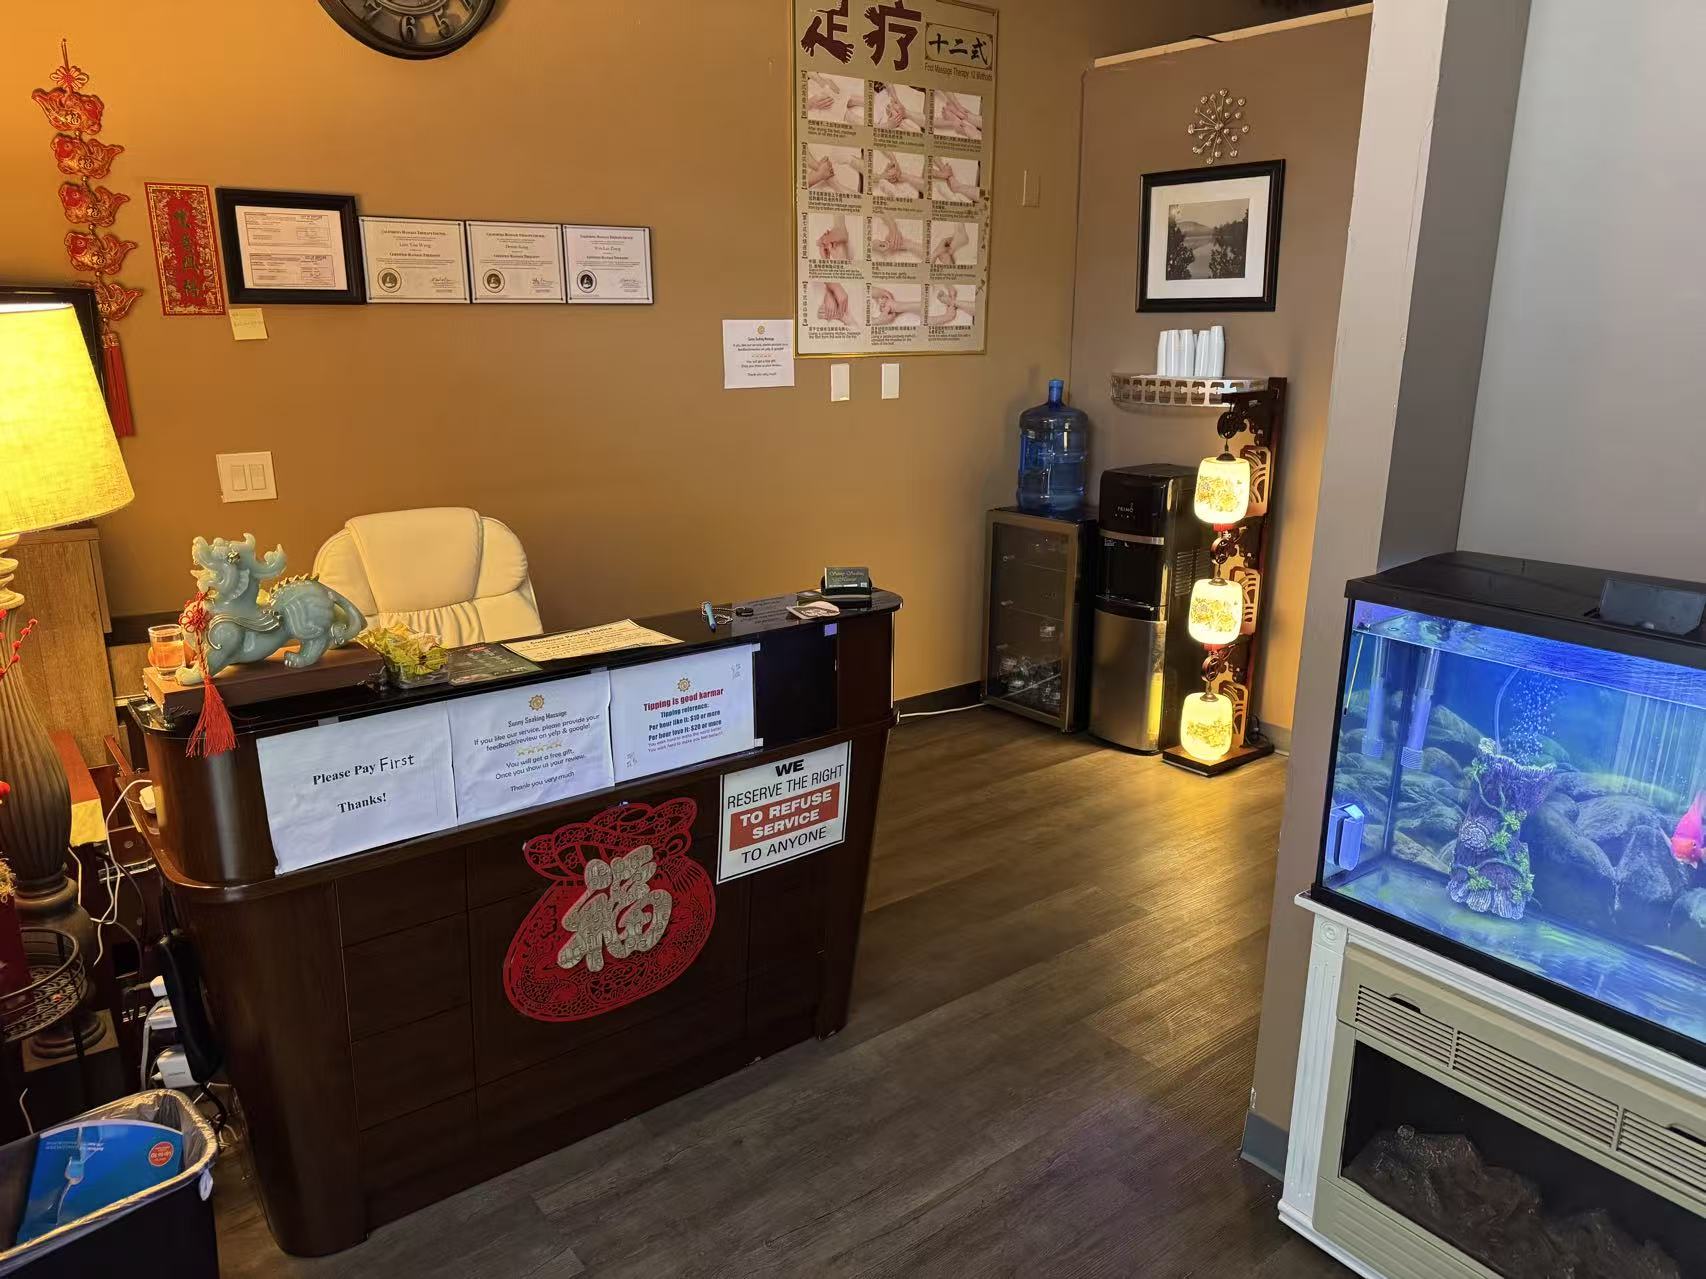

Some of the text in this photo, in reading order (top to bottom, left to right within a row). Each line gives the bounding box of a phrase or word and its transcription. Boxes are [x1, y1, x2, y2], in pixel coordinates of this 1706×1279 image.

[401, 15, 417, 42] 6
[433, 6, 452, 38] 5
[929, 33, 989, 66] 十二式
[643, 688, 724, 711] Tipping is good karmar
[507, 720, 524, 729] Sunny
[545, 710, 567, 719] Massage
[648, 724, 658, 732] Per
[659, 720, 672, 729] hour
[706, 709, 721, 718] more
[661, 708, 681, 718] Tipping
[480, 737, 494, 746] you
[494, 734, 506, 742] like
[506, 732, 518, 740] our
[518, 726, 540, 737] service,
[542, 722, 561, 732] please
[562, 716, 586, 727] provide
[585, 714, 601, 723] your
[538, 732, 547, 740] on
[547, 728, 562, 738] yelp
[561, 727, 568, 735] &
[568, 723, 591, 735] google!
[648, 734, 658, 742] Per
[658, 731, 672, 739] hour
[672, 727, 684, 736] love
[690, 723, 701, 732] $20
[707, 719, 722, 728] more
[312, 754, 415, 785] Please Pay First
[495, 772, 512, 780] Once
[512, 768, 525, 777] you
[525, 764, 542, 773] show
[550, 759, 564, 768] your
[506, 761, 520, 769] You
[520, 758, 532, 766] will
[775, 758, 805, 777] WE
[510, 770, 575, 792] Thank you very much
[727, 764, 845, 810] RESERVE THE RIGHT
[337, 792, 387, 814] Thanks!
[740, 788, 833, 827] TO REFUSE
[752, 808, 820, 840] SERVICE
[741, 825, 827, 864] TO ANYONE
[557, 845, 673, 973] 福
